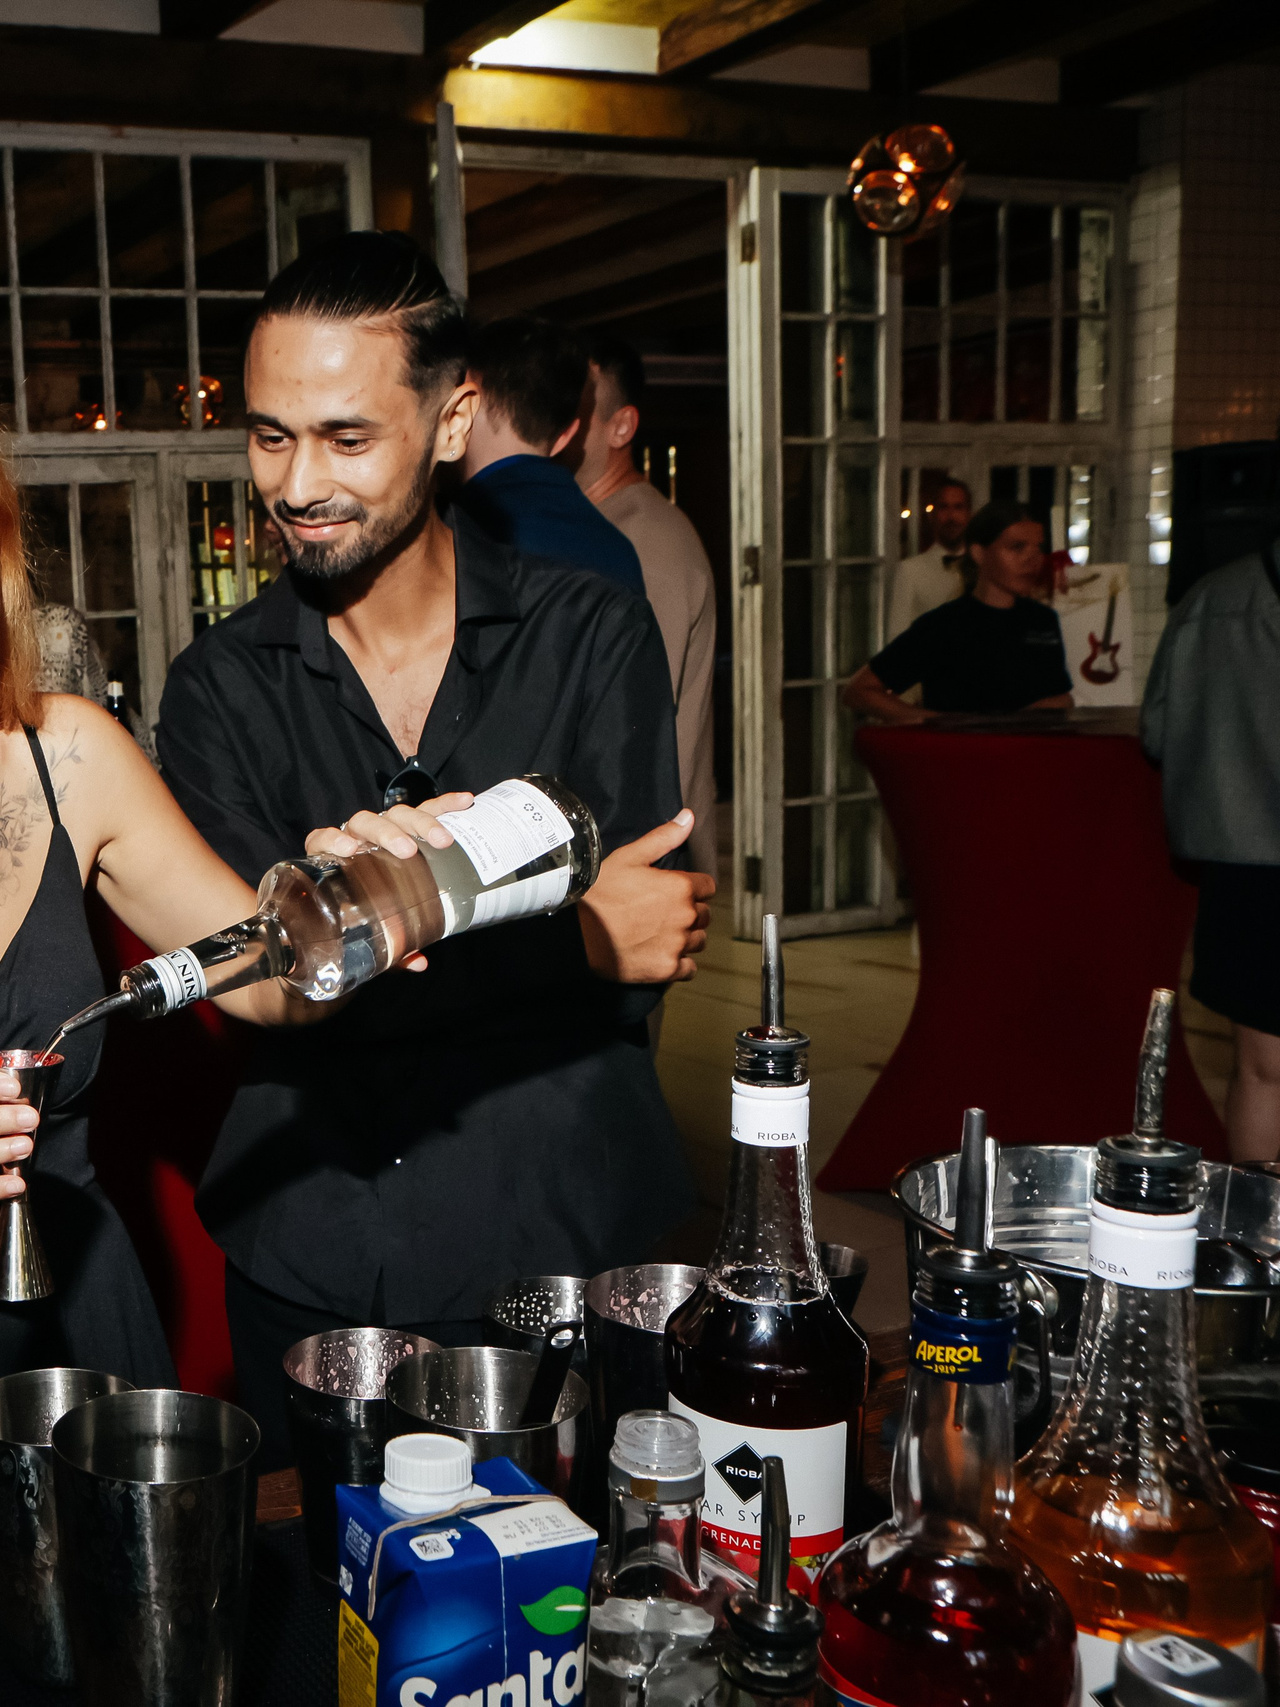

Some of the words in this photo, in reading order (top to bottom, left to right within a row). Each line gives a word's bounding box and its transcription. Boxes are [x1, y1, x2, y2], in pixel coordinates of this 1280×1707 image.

[757, 1131, 797, 1141] RIOBA
[915, 1339, 983, 1365] APEROL
[933, 1363, 957, 1375] 1919
[738, 1509, 806, 1526] SYP
